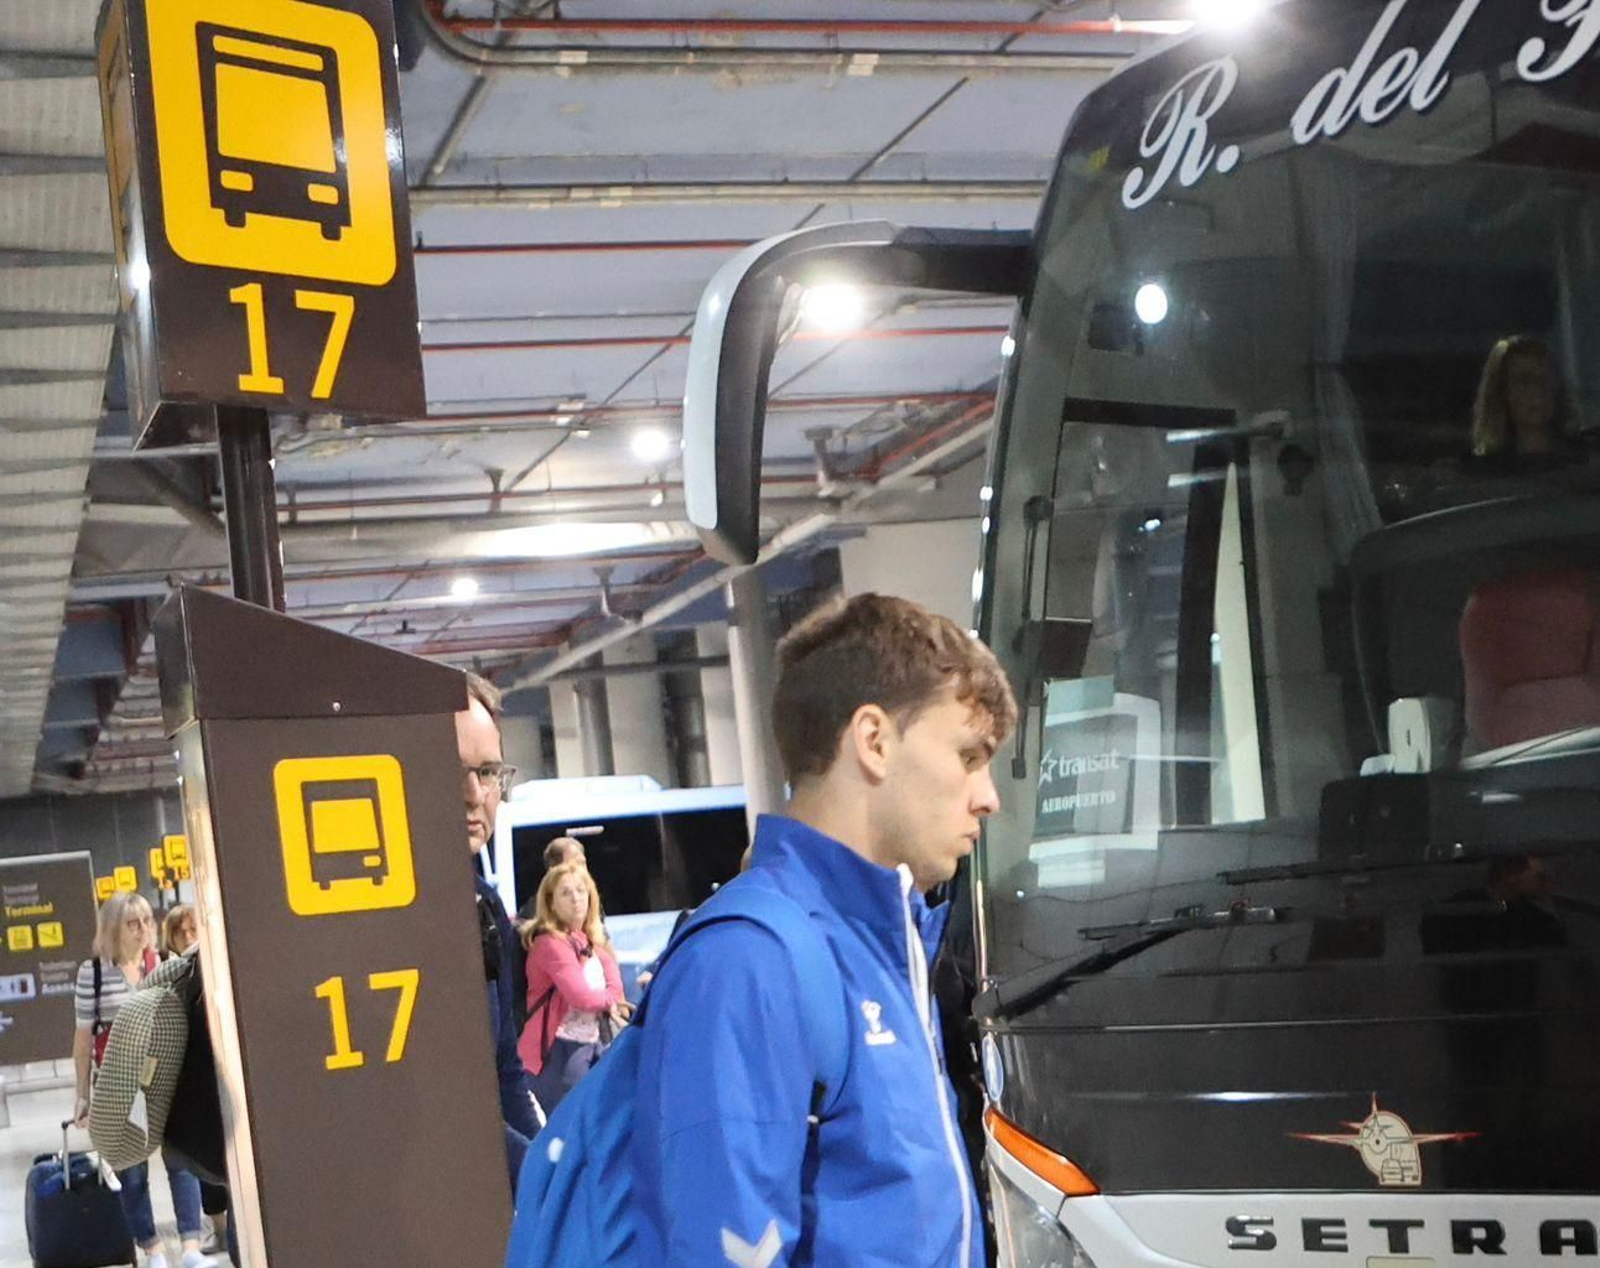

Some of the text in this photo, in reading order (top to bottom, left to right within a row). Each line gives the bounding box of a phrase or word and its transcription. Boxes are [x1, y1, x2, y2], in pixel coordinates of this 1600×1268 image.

[1121, 54, 1241, 210] R.
[1291, 0, 1481, 145] del
[229, 282, 355, 399] 17
[314, 968, 419, 1070] 17
[1225, 1215, 1599, 1256] SETRA
